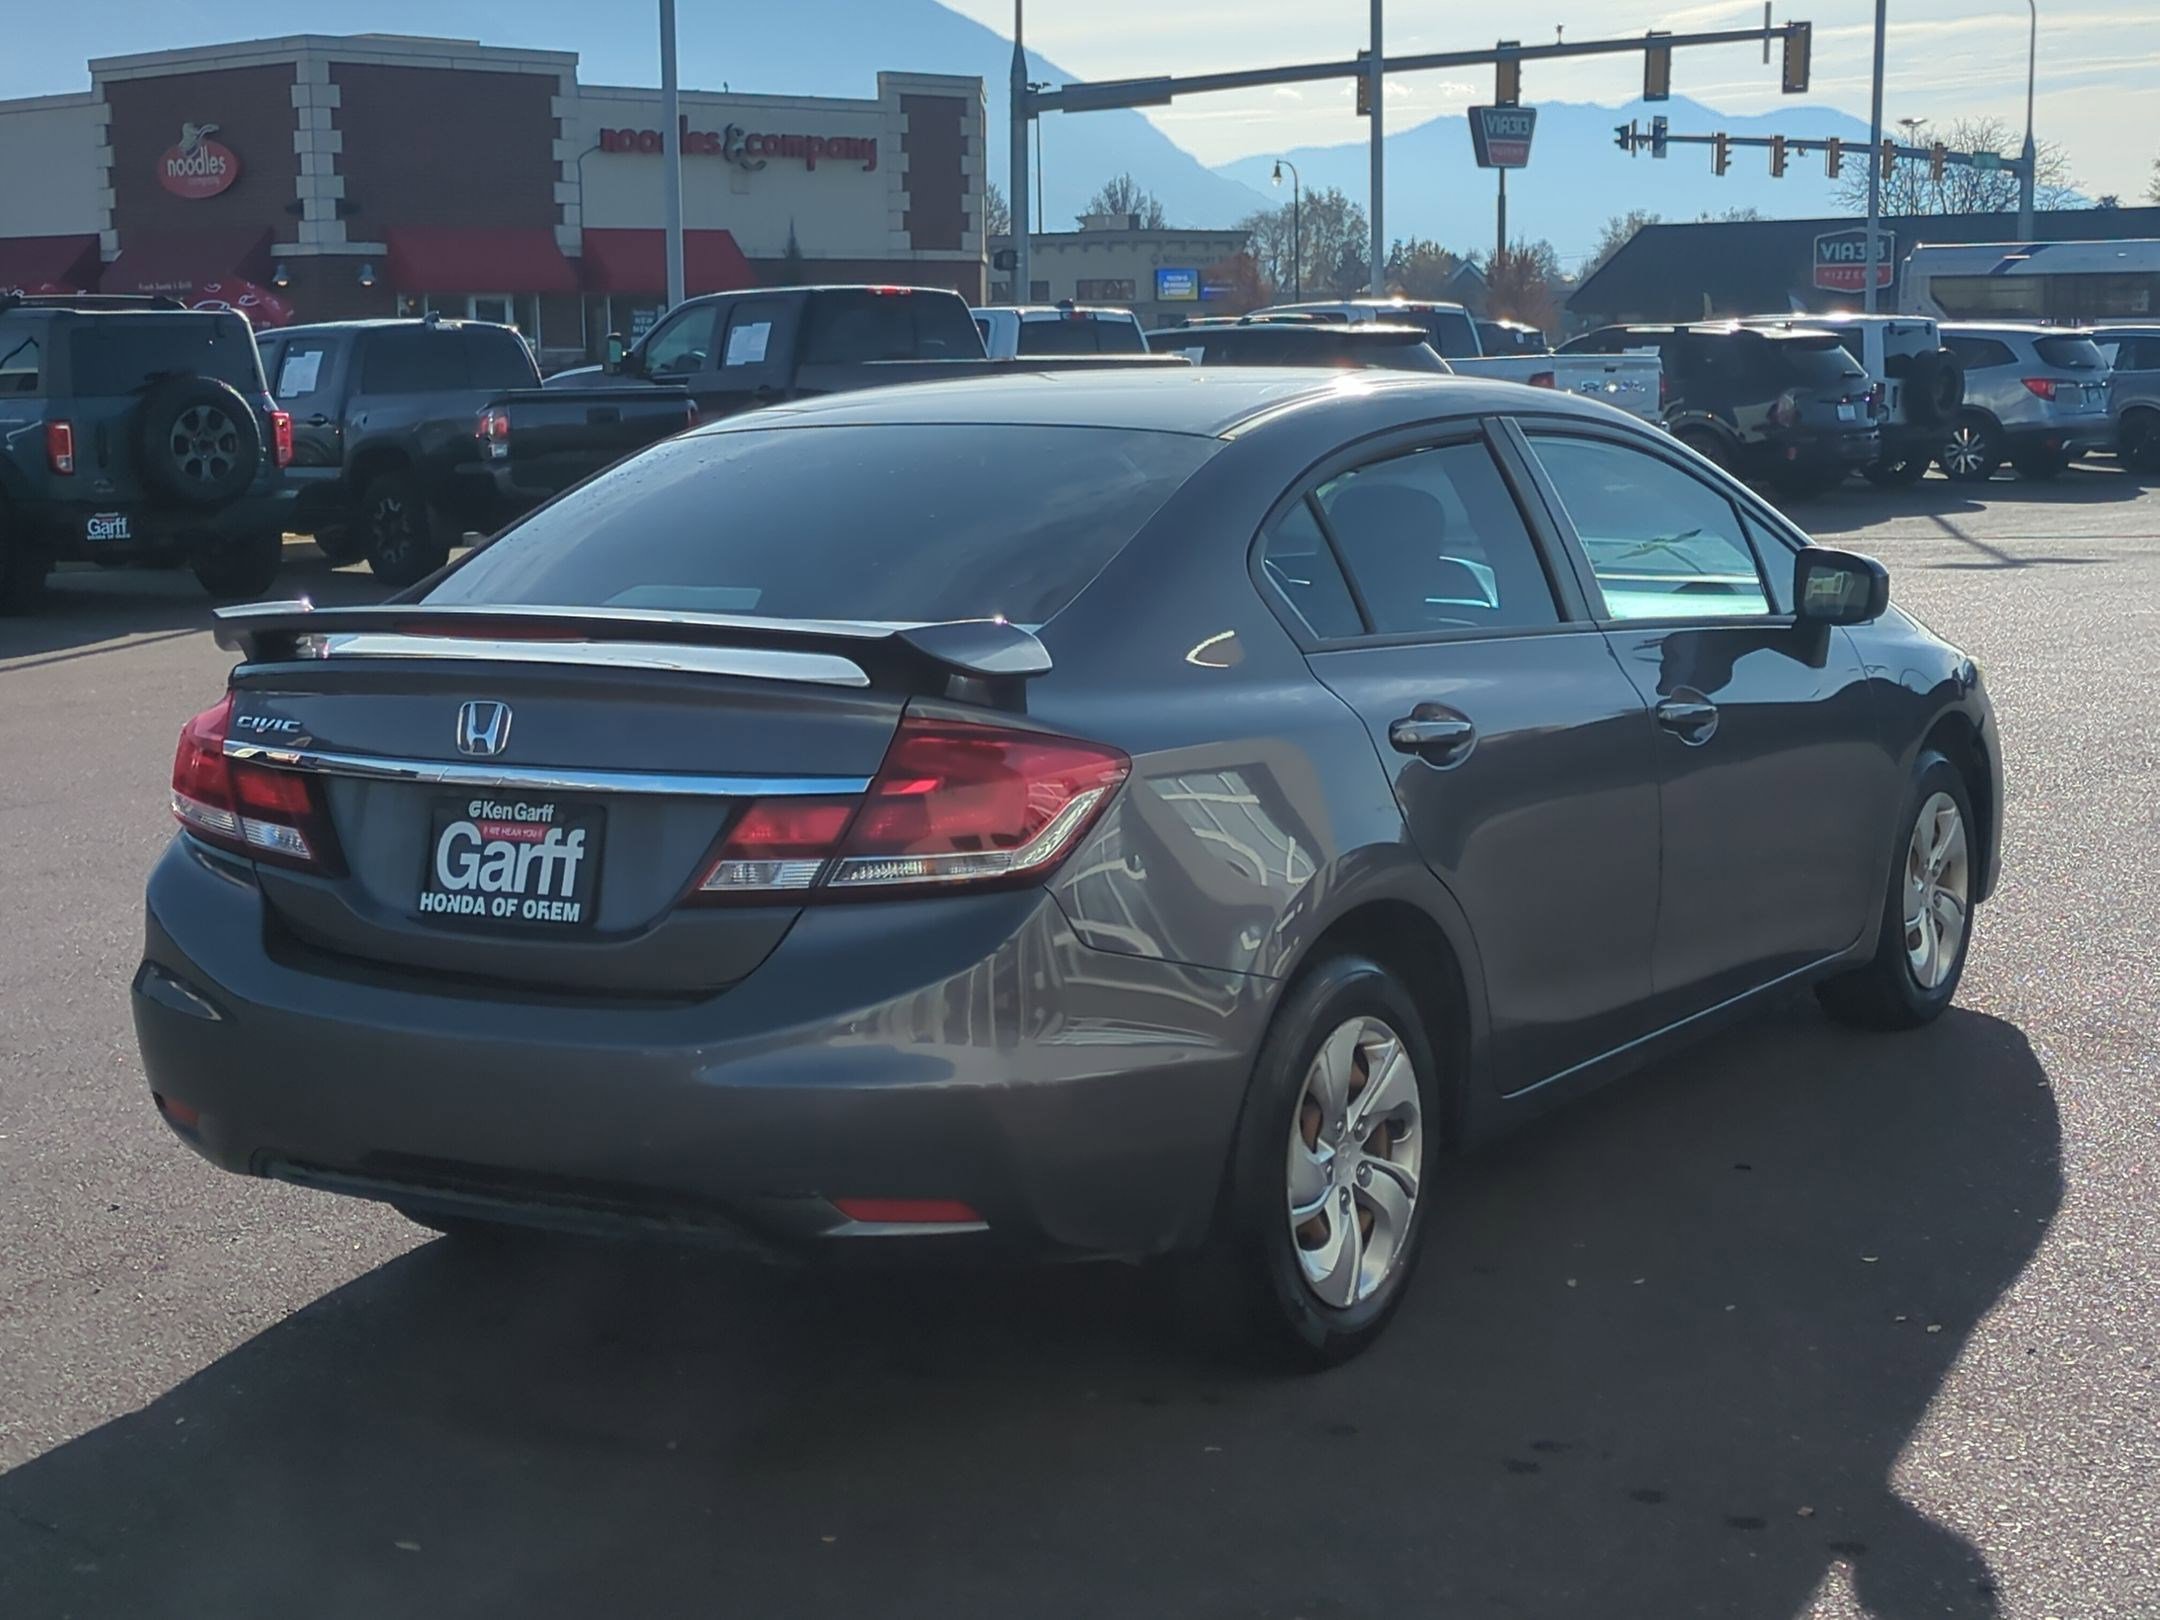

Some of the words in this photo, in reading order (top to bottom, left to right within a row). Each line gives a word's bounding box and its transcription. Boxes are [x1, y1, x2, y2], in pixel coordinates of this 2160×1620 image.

[600, 114, 721, 154] nooles
[745, 133, 877, 172] company
[167, 145, 226, 176] noodles
[1820, 241, 1885, 260] VIA33
[88, 517, 128, 536] Garff
[237, 715, 301, 733] CIVIC
[482, 801, 513, 819] Ken
[514, 802, 554, 822] Garff
[501, 827, 522, 837] HEAR
[523, 829, 538, 839] YOU
[437, 820, 586, 897] Garff
[420, 892, 486, 915] HONDA
[491, 897, 518, 917] OF
[522, 900, 581, 923] OREM
